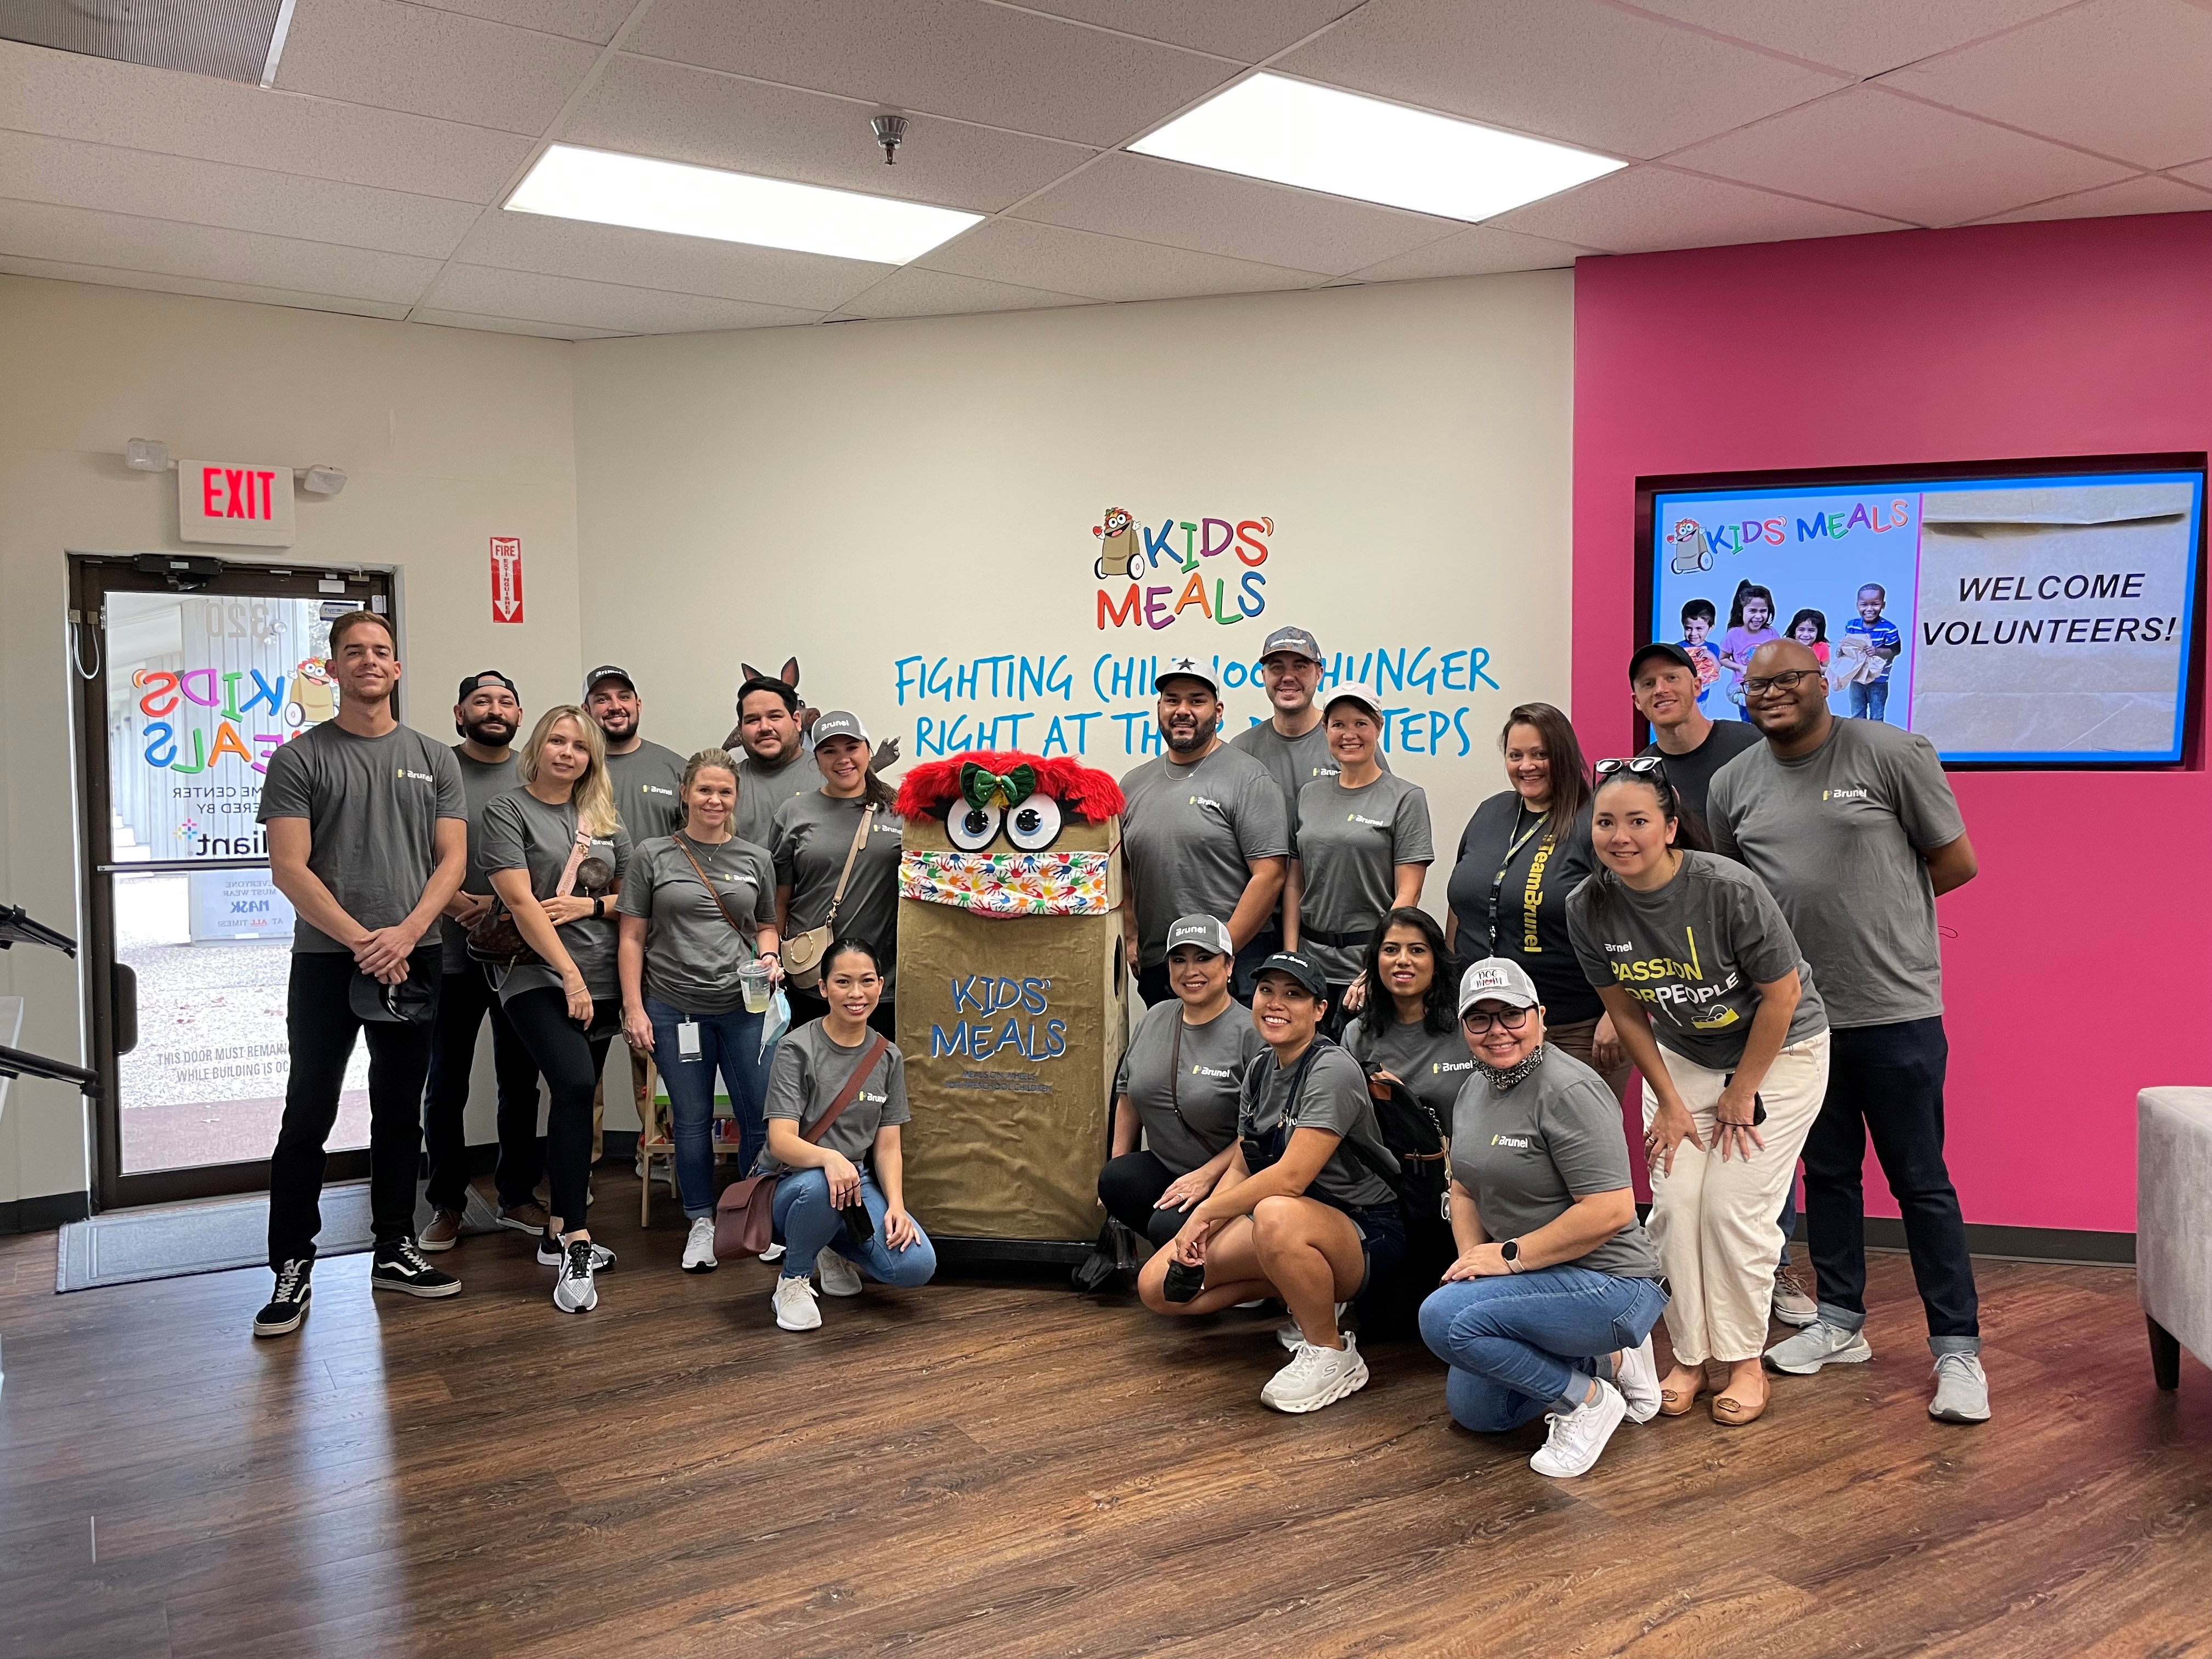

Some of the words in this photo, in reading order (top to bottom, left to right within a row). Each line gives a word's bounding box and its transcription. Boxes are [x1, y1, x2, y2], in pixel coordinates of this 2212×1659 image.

[202, 467, 276, 520] EXIT
[1796, 500, 1908, 543] MEALS
[495, 545, 515, 557] FIRE
[1959, 573, 2146, 602] WELCOME
[1097, 571, 1266, 630] MEALS
[1923, 617, 2177, 645] VOLUNTEERS!
[895, 654, 1073, 707] FIGHTING
[1317, 646, 1500, 696] HUNGER
[821, 720, 849, 731] Brunel
[916, 713, 1035, 758] RIGHT
[1042, 712, 1103, 758] AT
[651, 786, 673, 795] Brunel
[1833, 789, 1867, 798] Brunel
[1176, 926, 1206, 936] Brunel
[932, 1018, 1067, 1062] MEALS
[157, 1051, 180, 1065] THIS
[184, 1049, 212, 1063] DOOR
[216, 1047, 245, 1060] MUST
[177, 1068, 210, 1082] WHILE
[212, 1063, 260, 1079] BUILDING
[1201, 1066, 1230, 1078] Brunel
[1442, 1059, 1473, 1072] Brunel
[1498, 1136, 1528, 1148] Brunel
